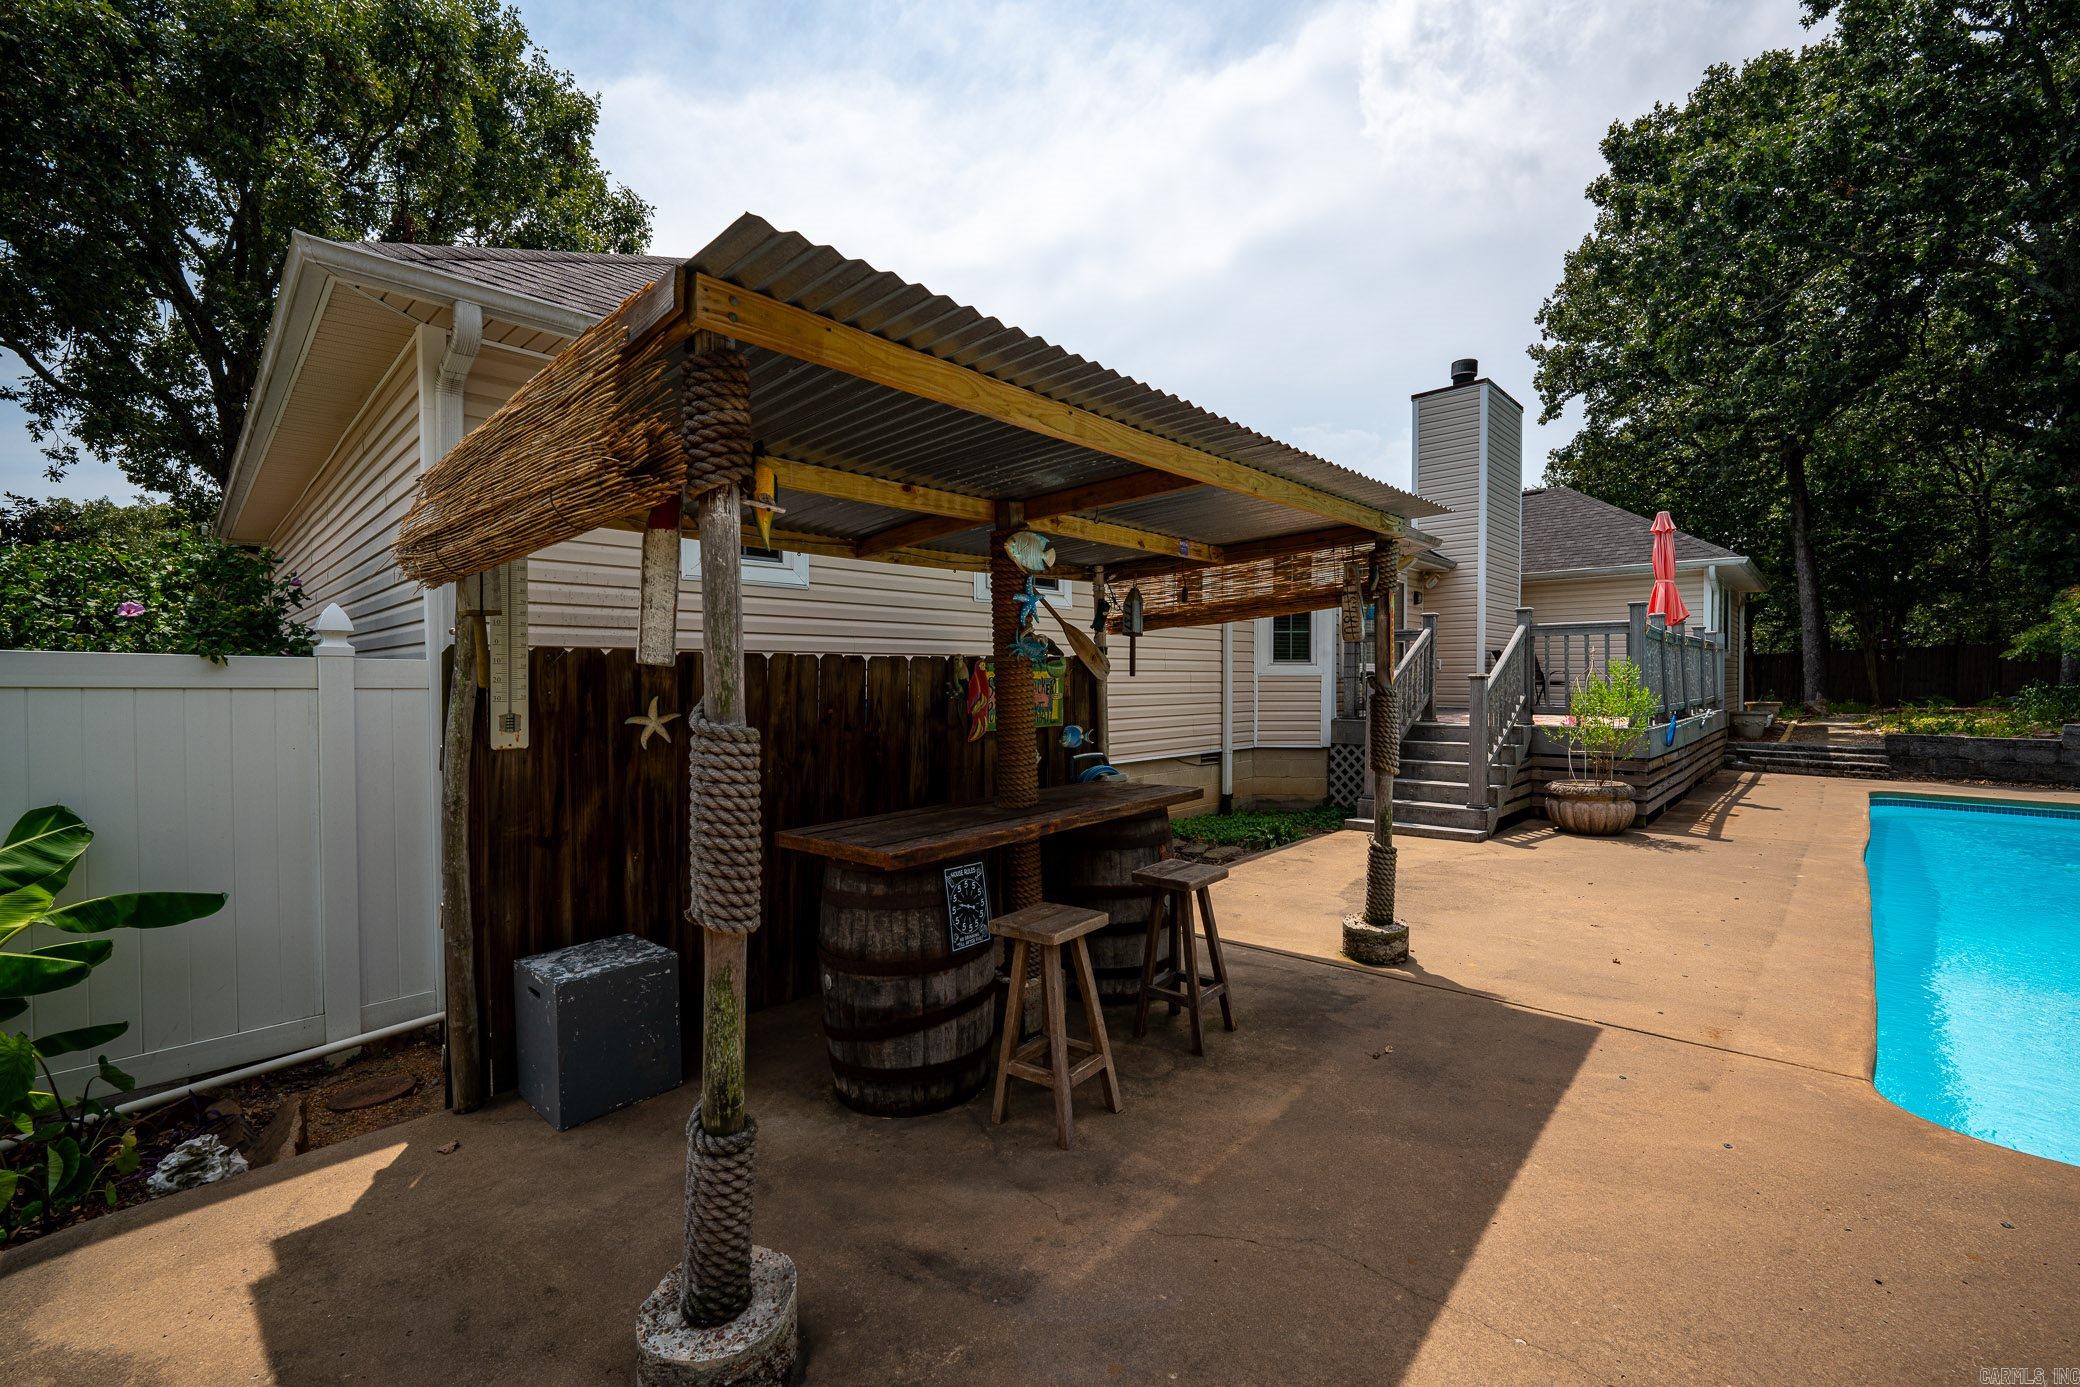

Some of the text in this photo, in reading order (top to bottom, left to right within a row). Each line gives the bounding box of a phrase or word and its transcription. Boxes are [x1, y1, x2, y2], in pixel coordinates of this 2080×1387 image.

[950, 867, 976, 878] HOUSE RULES
[957, 885, 962, 893] 5
[964, 881, 968, 889] 5
[971, 882, 976, 890] 5
[977, 888, 982, 896] 5
[952, 907, 957, 915] 5
[979, 910, 984, 918] 5
[955, 917, 960, 925] 5
[974, 919, 979, 928] 5
[962, 923, 967, 931] 5
[969, 924, 973, 932] 5
